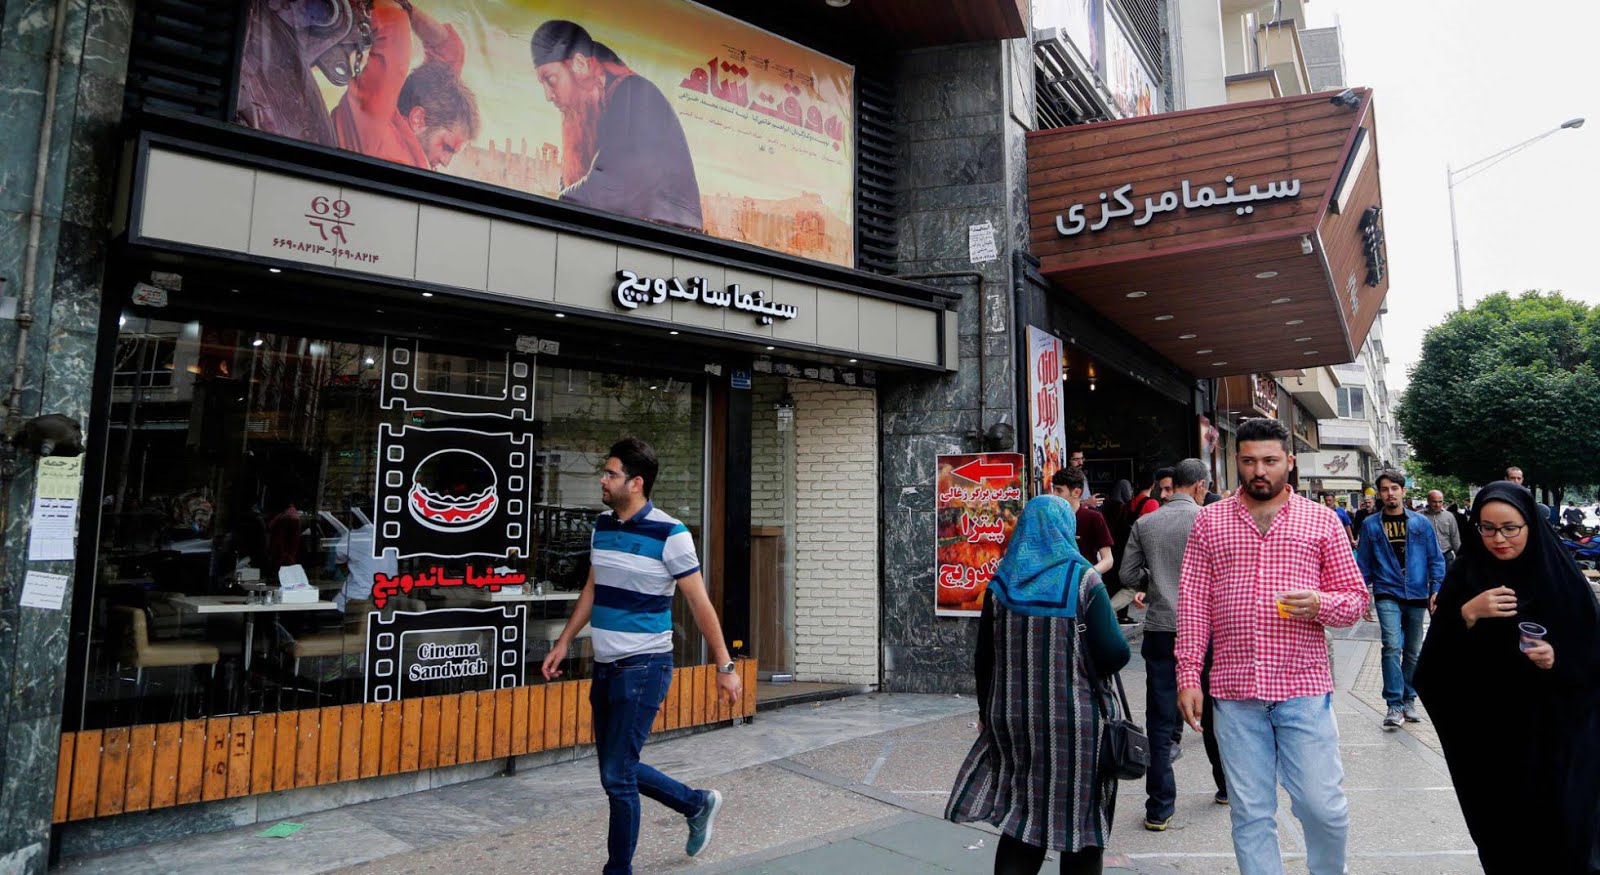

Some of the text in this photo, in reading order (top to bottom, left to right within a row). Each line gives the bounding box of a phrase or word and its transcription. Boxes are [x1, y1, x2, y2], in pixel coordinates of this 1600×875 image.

[679, 57, 844, 152] به وقت شام
[311, 196, 351, 219] 69
[1055, 175, 1301, 236] سینما مرکزی
[616, 270, 798, 325] سینما ساندویچ
[43, 459, 79, 471] ترجمه
[991, 487, 1021, 502] بهترین
[961, 512, 1005, 543] پیتزا
[1384, 521, 1406, 538] RVA
[372, 565, 528, 608] سینما ساندویچ
[939, 558, 1003, 589] ندویچ
[417, 642, 480, 661] Cinema
[409, 658, 488, 682] Sandwich
